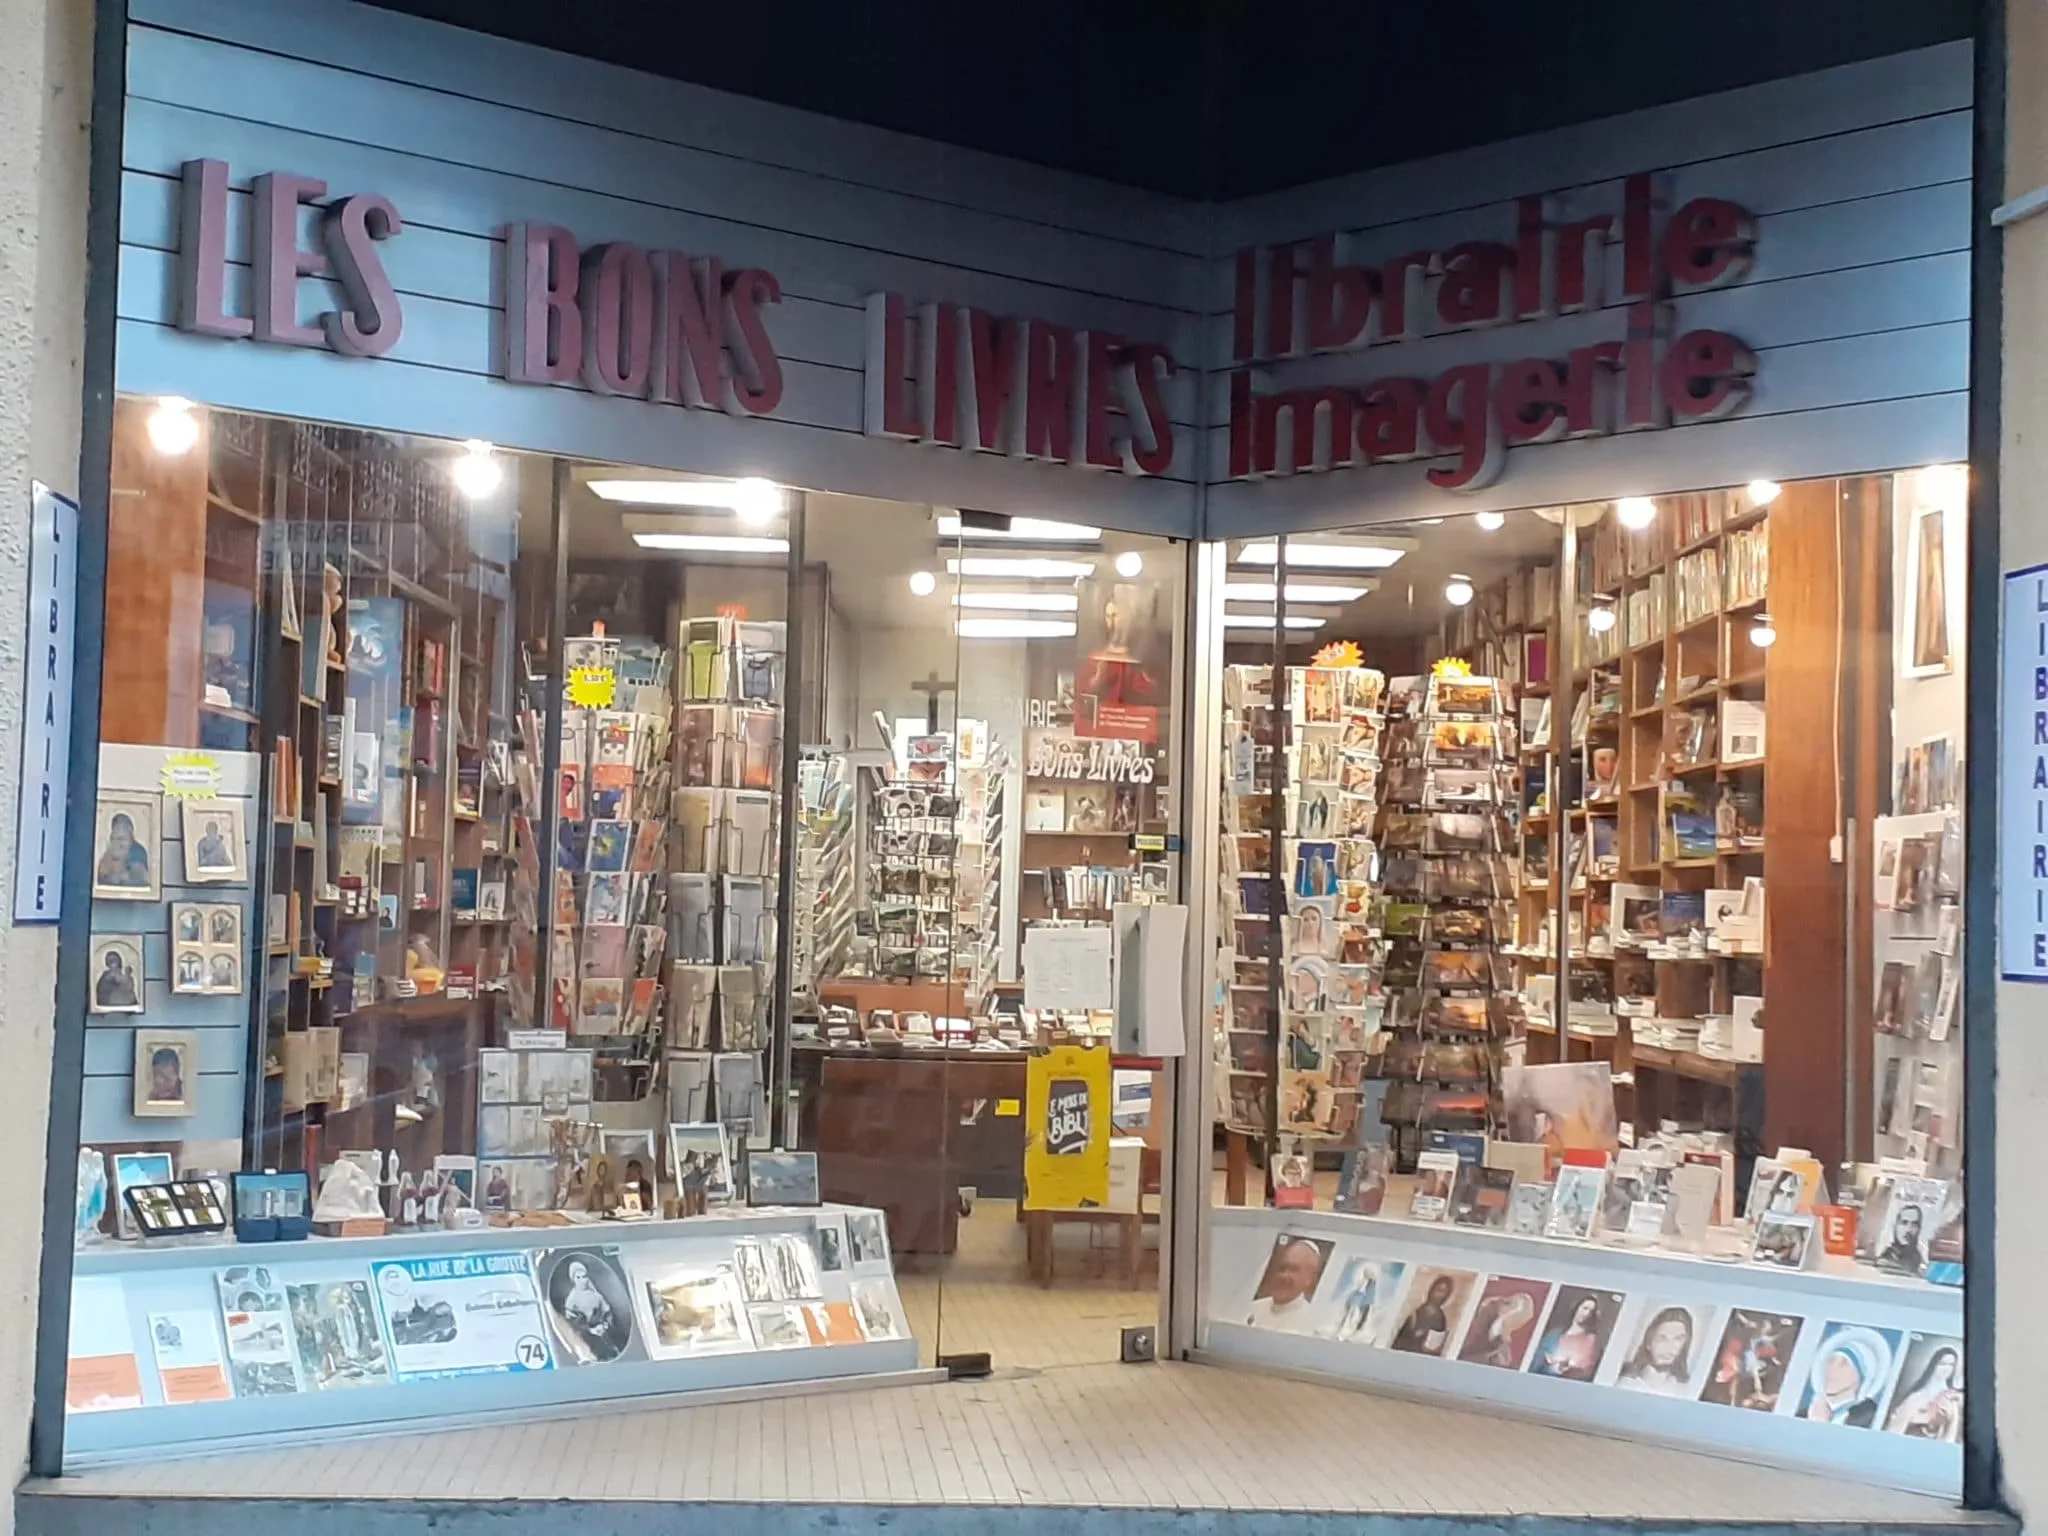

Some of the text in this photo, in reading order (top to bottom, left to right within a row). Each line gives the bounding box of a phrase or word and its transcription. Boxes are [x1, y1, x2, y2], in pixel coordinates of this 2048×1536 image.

[178, 158, 1177, 476] LES BONS LIVRES
[36, 507, 60, 911] LIBRAIRIE
[519, 1343, 545, 1365] 74
